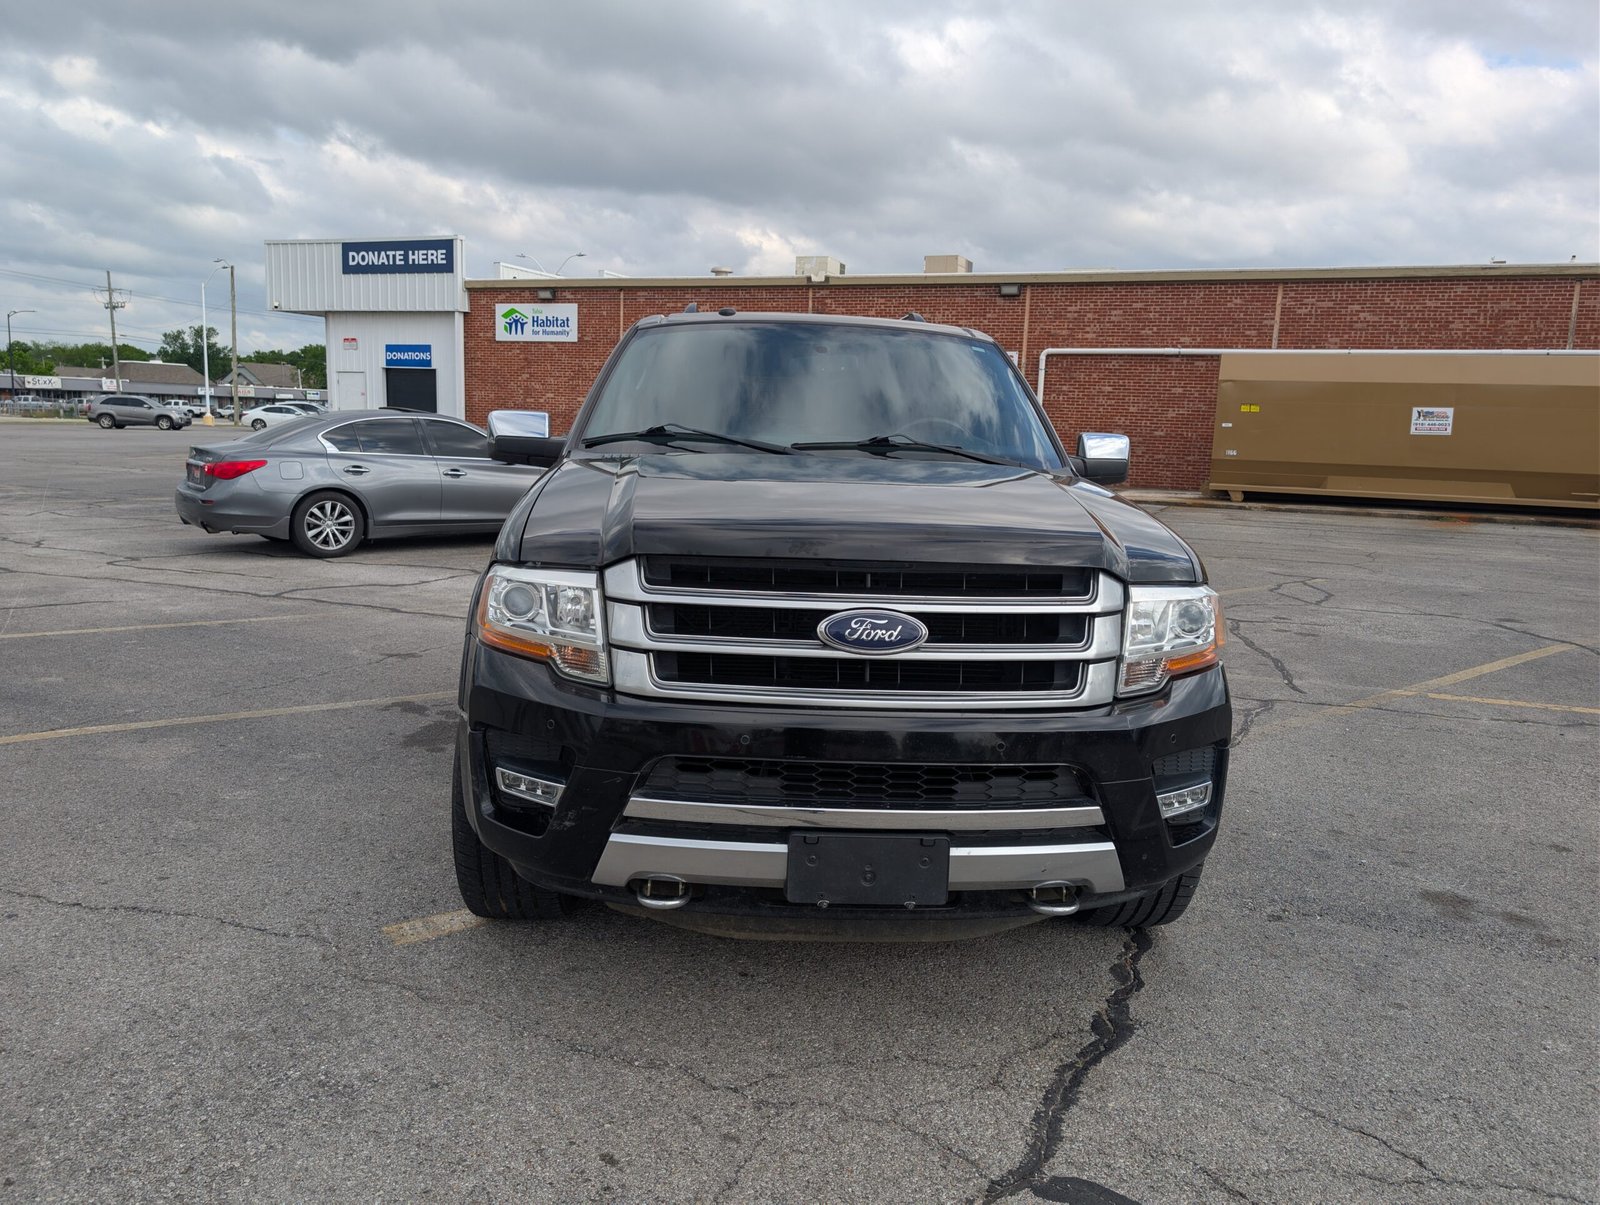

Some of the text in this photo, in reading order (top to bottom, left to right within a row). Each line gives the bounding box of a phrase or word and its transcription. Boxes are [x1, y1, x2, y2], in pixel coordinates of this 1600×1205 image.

[348, 249, 447, 266] DONATE HERE
[531, 315, 570, 328] Habitat
[531, 328, 570, 338] for Humanity
[386, 351, 431, 360] DONATIONS
[844, 617, 903, 642] Ford
